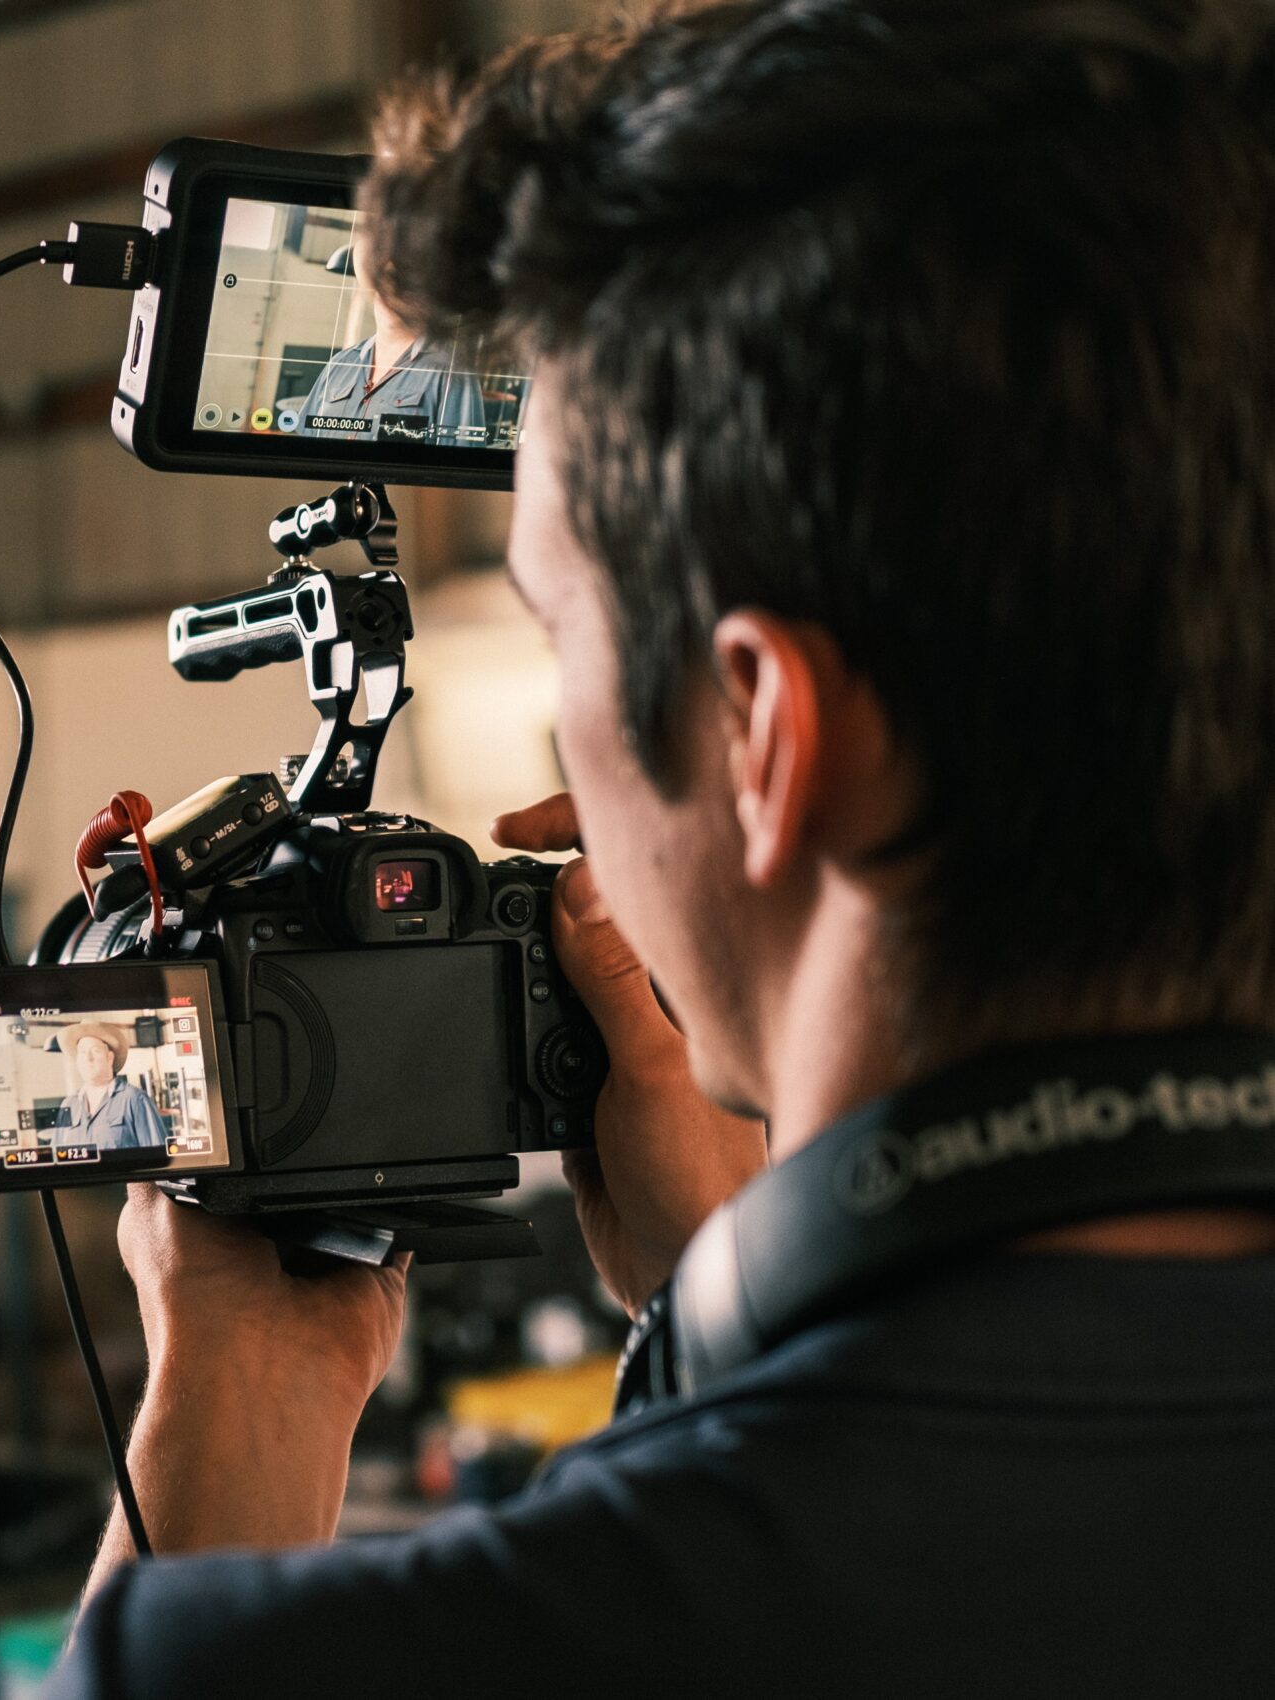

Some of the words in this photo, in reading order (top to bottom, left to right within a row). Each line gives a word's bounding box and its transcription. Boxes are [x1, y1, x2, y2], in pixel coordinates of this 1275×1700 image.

[122, 240, 134, 280] HDMI
[312, 416, 365, 431] 00:00:00:00
[259, 792, 275, 803] 1/2
[181, 858, 194, 871] dB
[533, 986, 548, 995] INFO
[567, 1057, 581, 1067] SET
[17, 1150, 39, 1163] 1/50
[67, 1147, 88, 1160] F2.8
